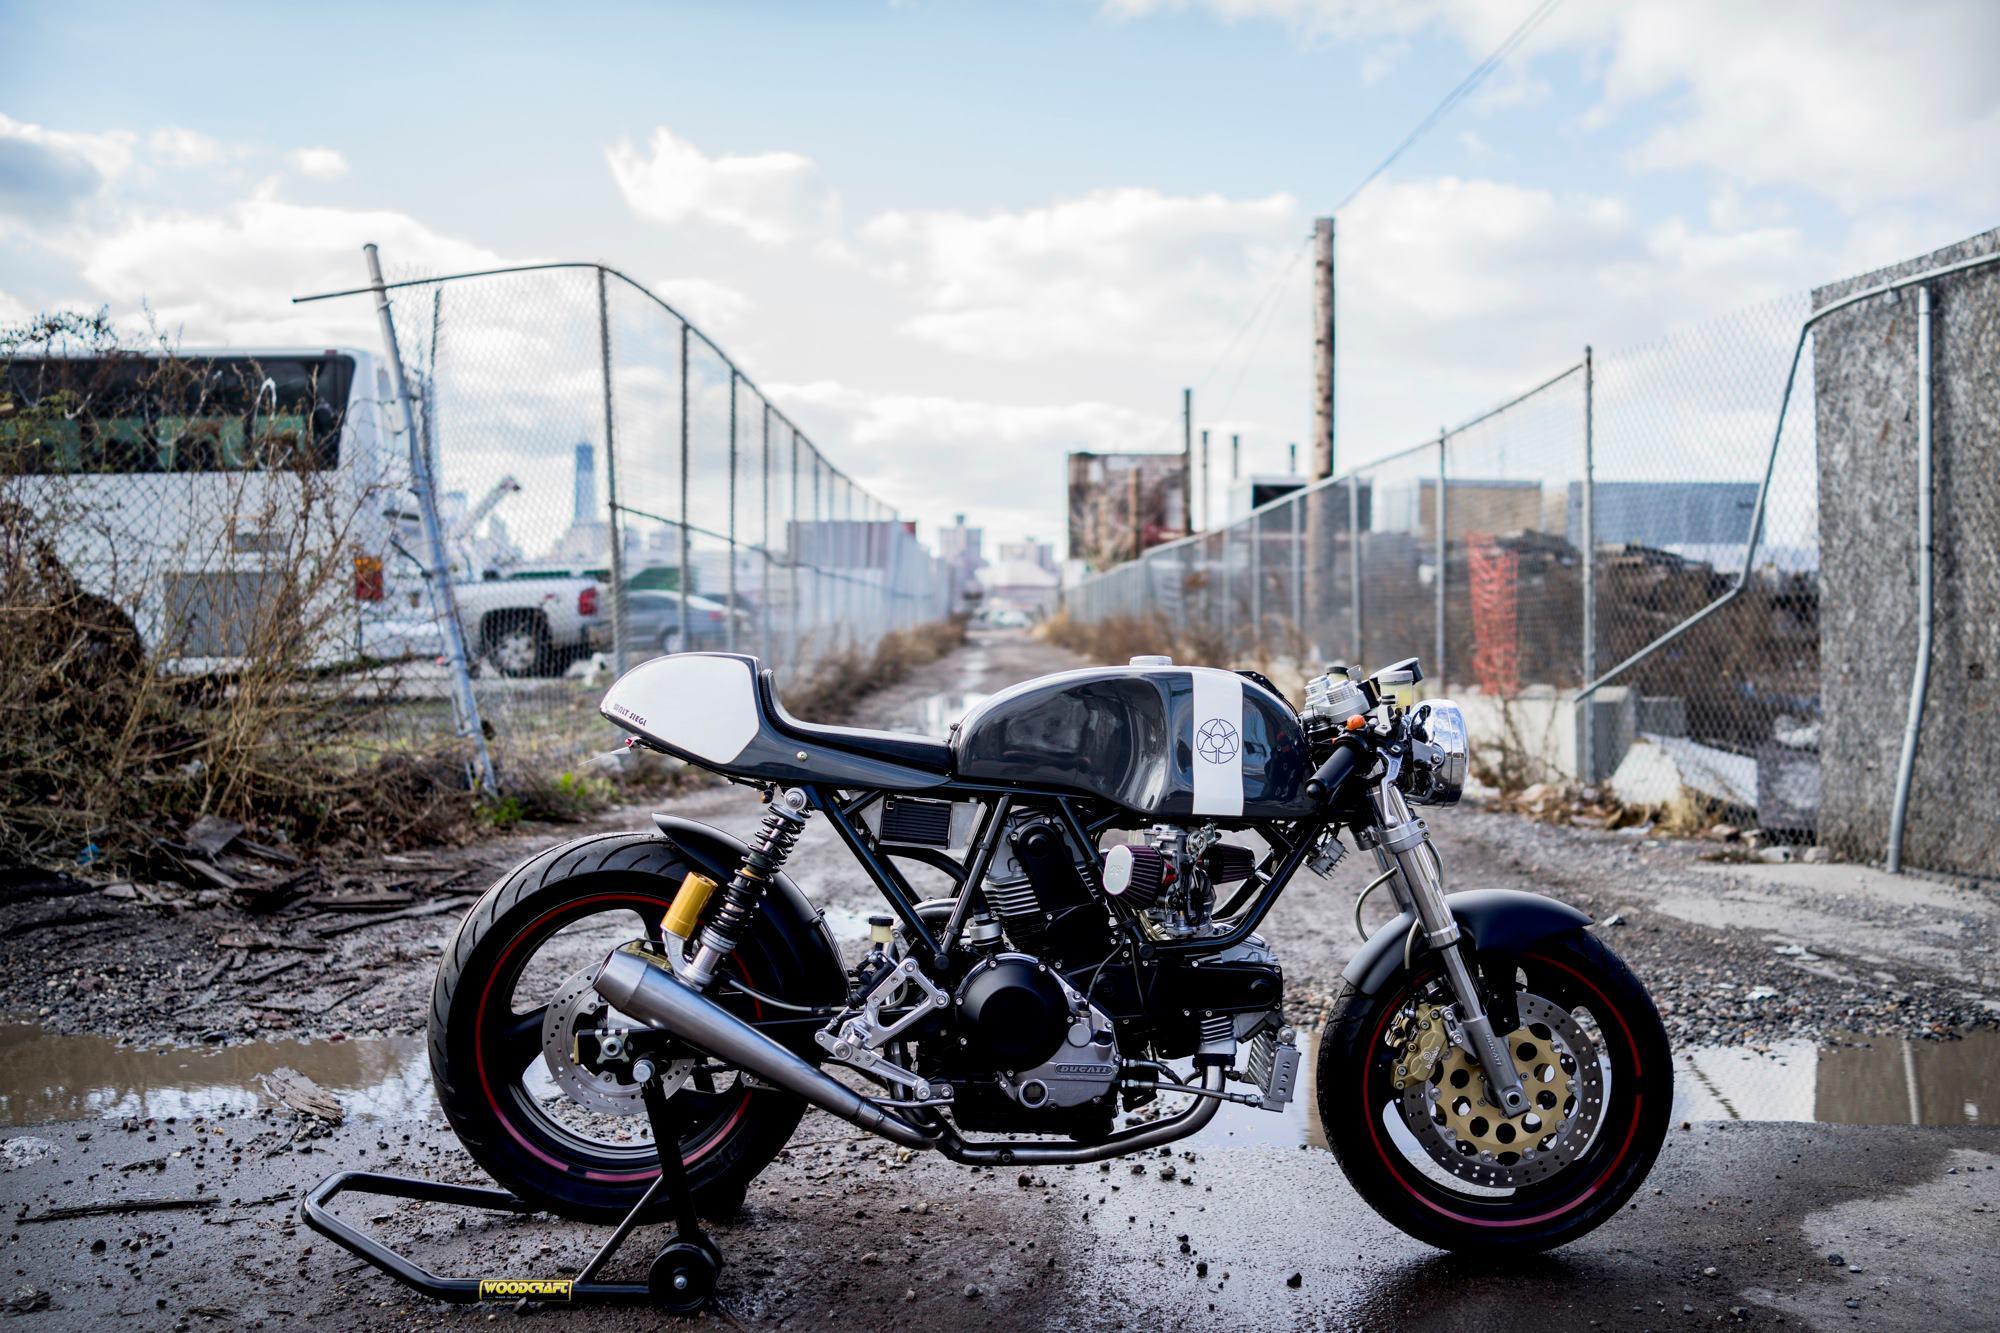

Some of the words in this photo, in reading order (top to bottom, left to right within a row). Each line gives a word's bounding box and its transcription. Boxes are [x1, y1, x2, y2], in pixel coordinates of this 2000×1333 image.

[629, 711, 647, 727] SIEGL
[1060, 1065, 1107, 1073] DUCATI
[484, 1282, 569, 1294] WOODCRAFT
